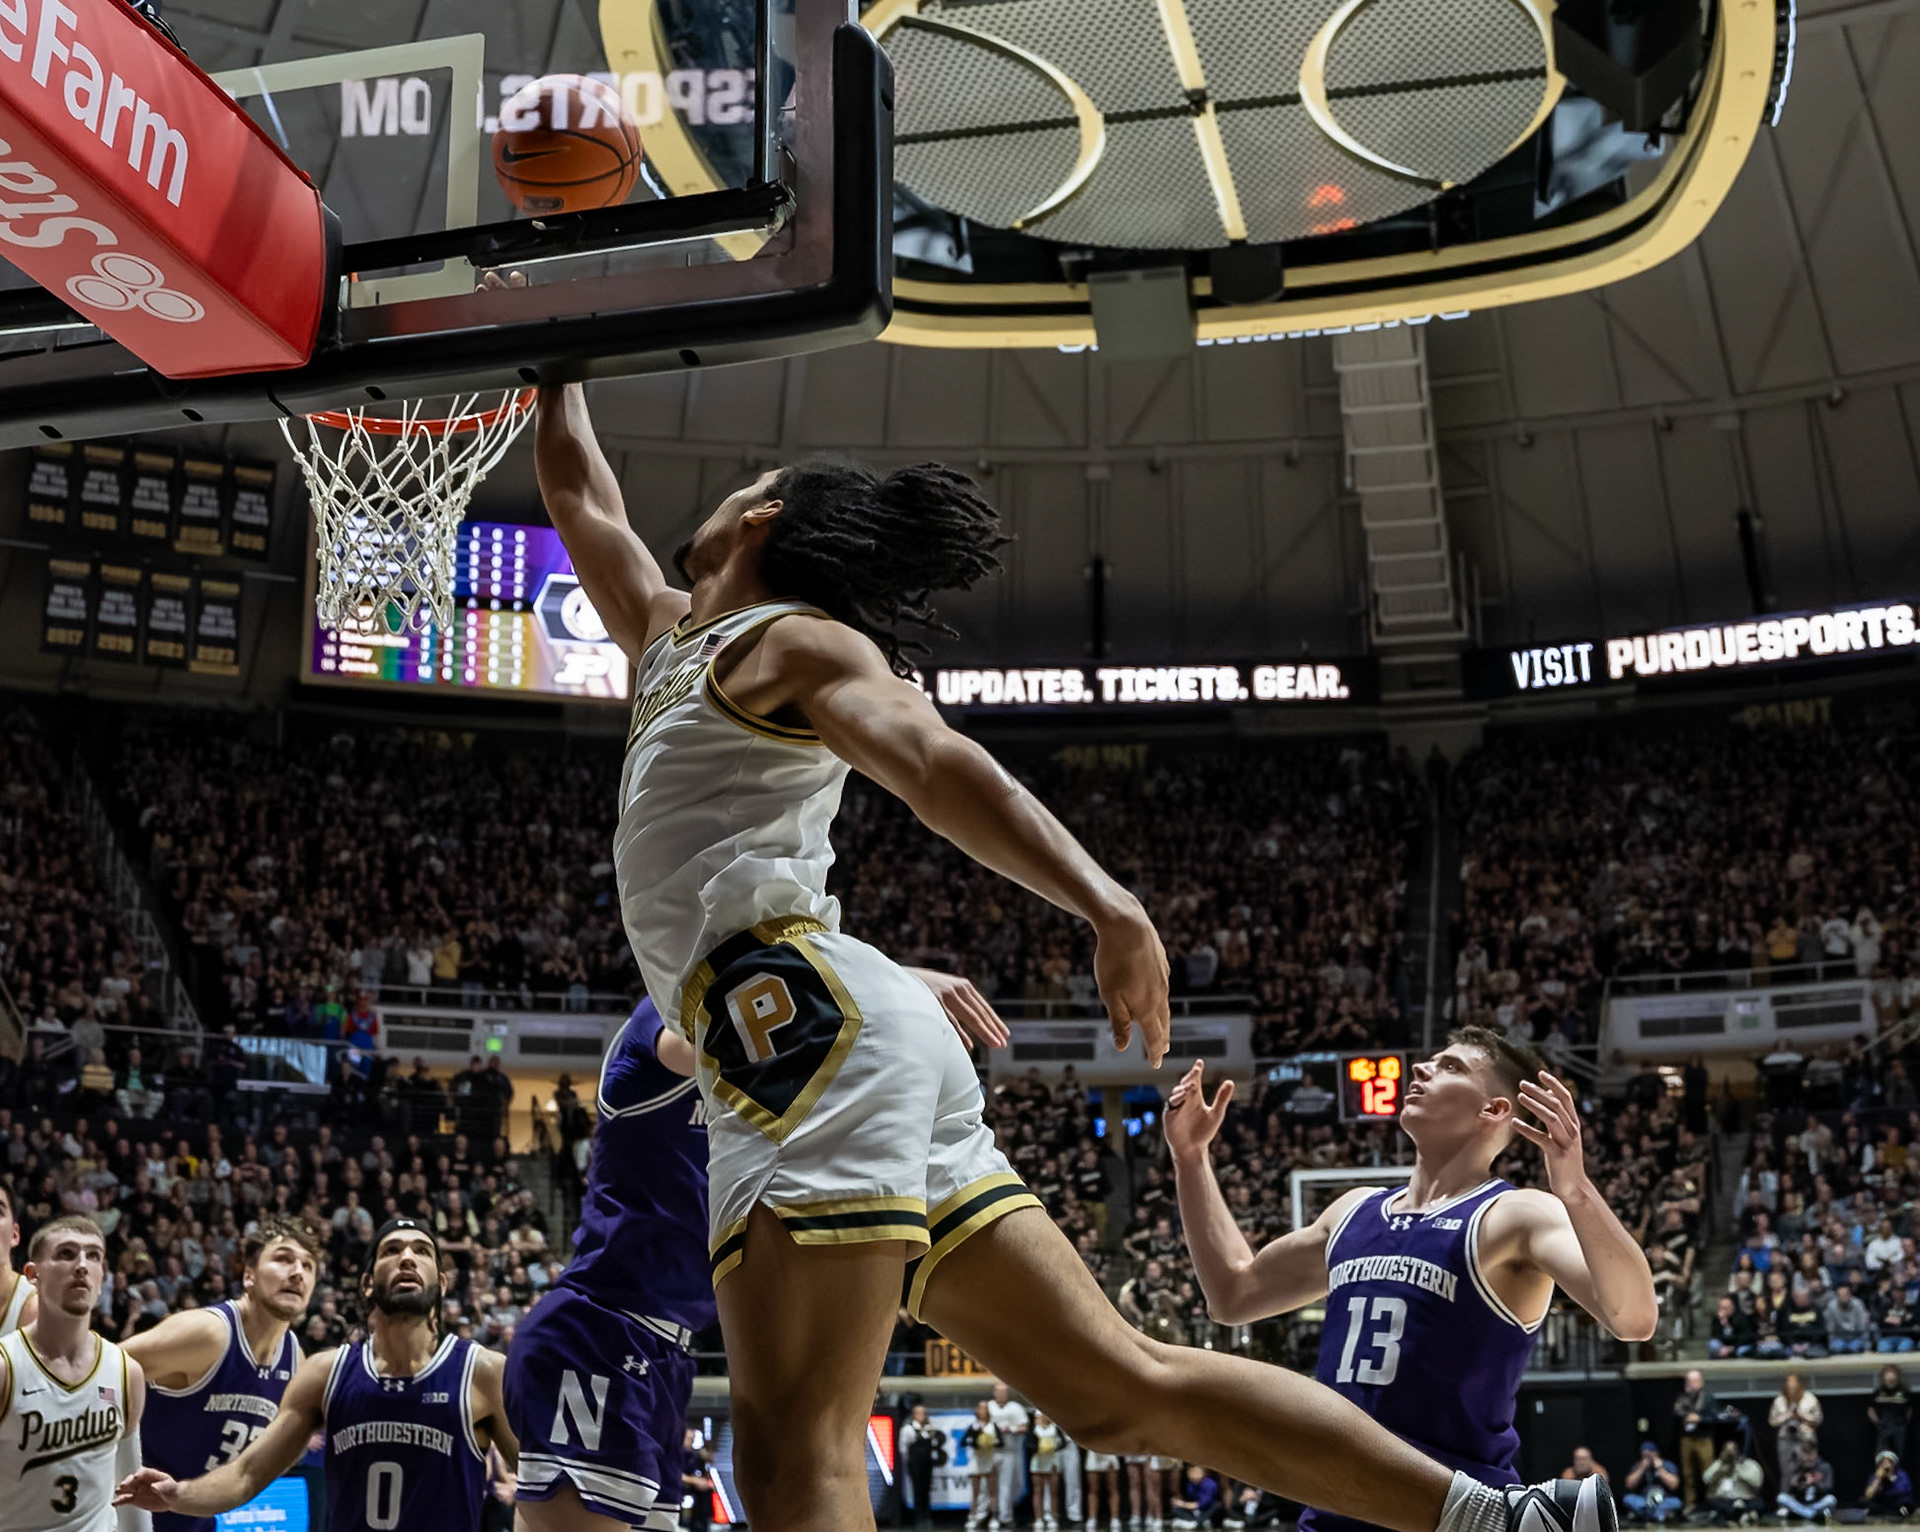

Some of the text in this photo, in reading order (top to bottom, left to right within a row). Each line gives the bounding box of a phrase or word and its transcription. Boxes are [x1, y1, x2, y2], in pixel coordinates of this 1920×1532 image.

[937, 668, 1094, 704] UPDATES.
[1098, 665, 1249, 701] TICKETS.
[1252, 664, 1351, 699] GEAR.
[1510, 643, 1593, 689] VISIT
[725, 972, 797, 1063] P
[1361, 1077, 1397, 1115] 12
[1335, 1296, 1408, 1386] 13
[18, 1402, 120, 1452] Purdue
[549, 1369, 610, 1451] N
[332, 1421, 455, 1457] NORTHWESTERN
[50, 1475, 79, 1514] 3
[365, 1461, 404, 1531] 0
